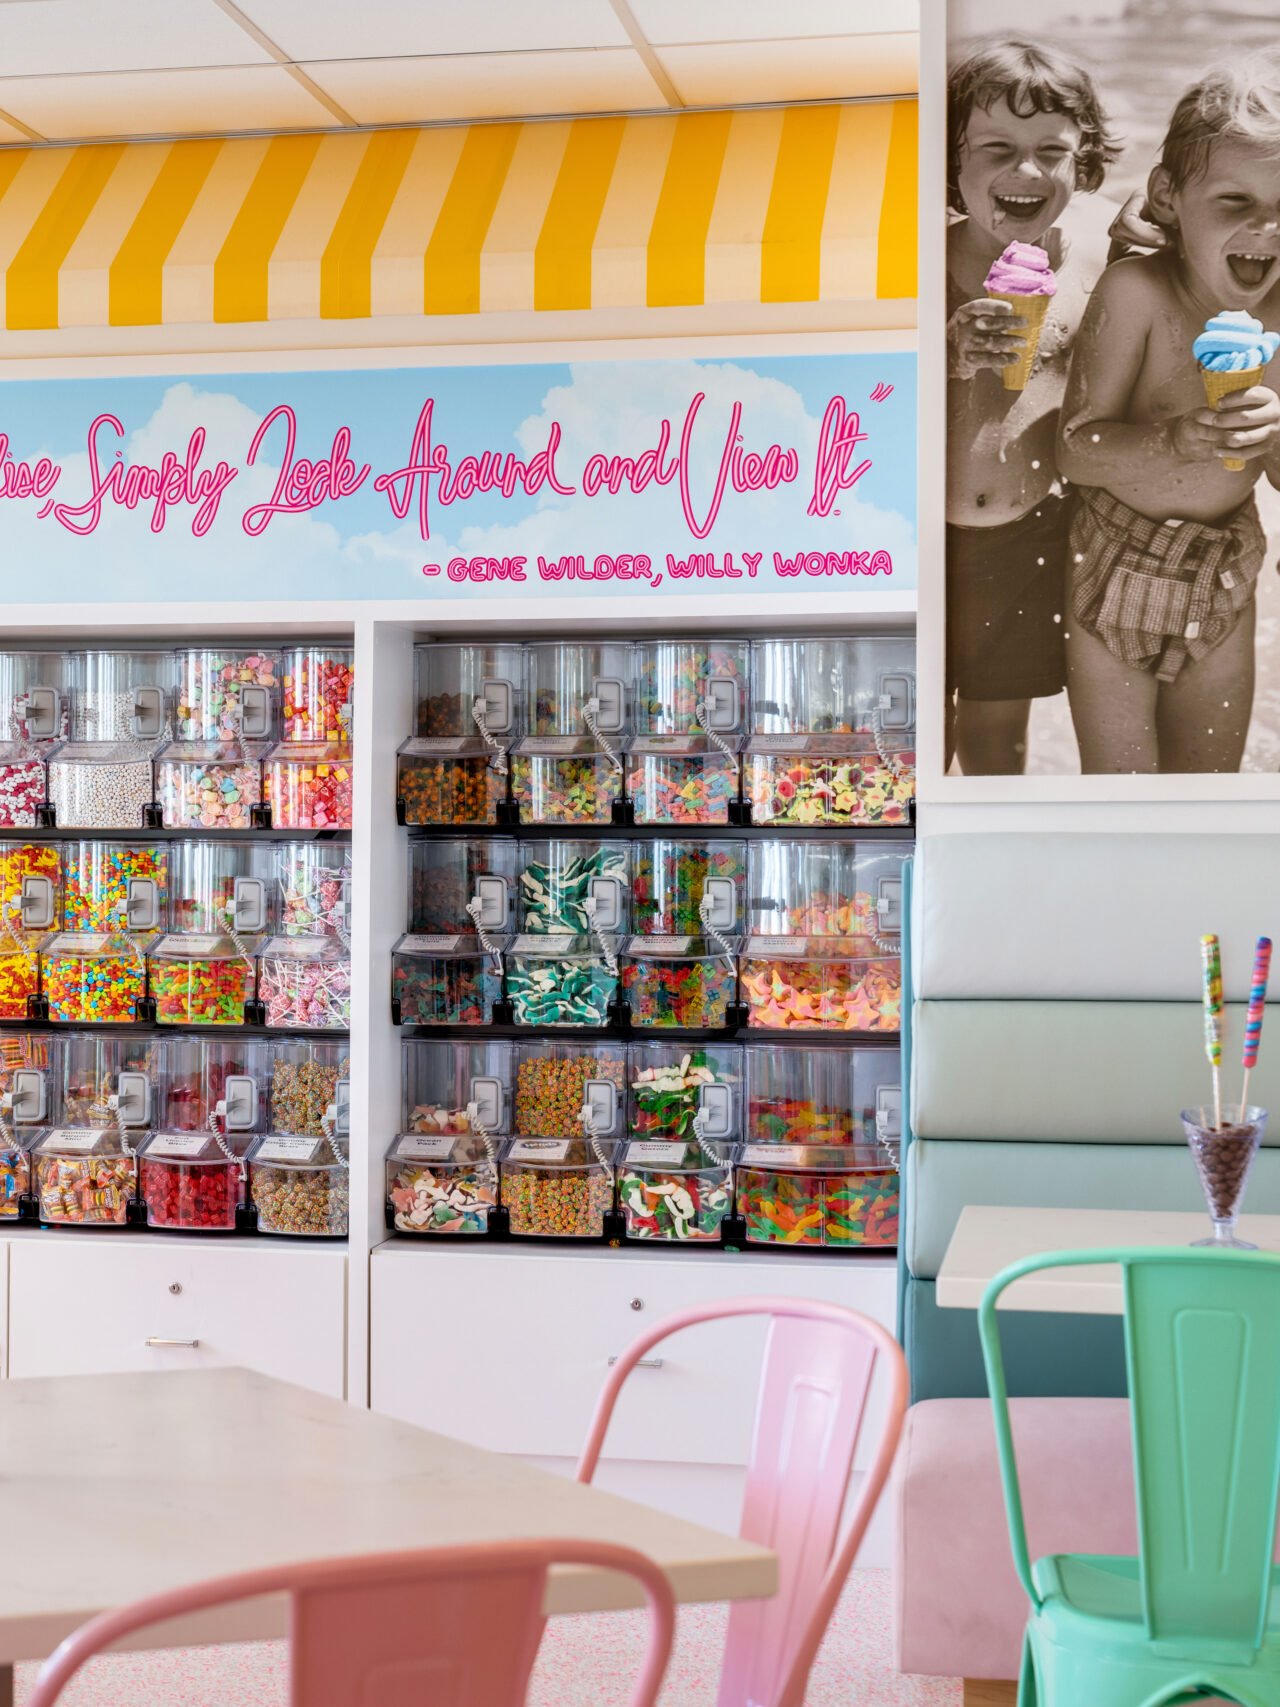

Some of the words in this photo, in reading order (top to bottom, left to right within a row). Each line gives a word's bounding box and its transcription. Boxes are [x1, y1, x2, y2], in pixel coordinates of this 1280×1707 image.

[54, 414, 238, 537] Simply
[242, 405, 371, 537] Look
[374, 398, 576, 540] Around
[582, 420, 677, 498] and
[678, 392, 799, 539] View
[447, 556, 527, 582] GENE
[537, 554, 663, 588] WILDER,
[666, 552, 763, 578] WILLY
[773, 550, 893, 577] WONKA
